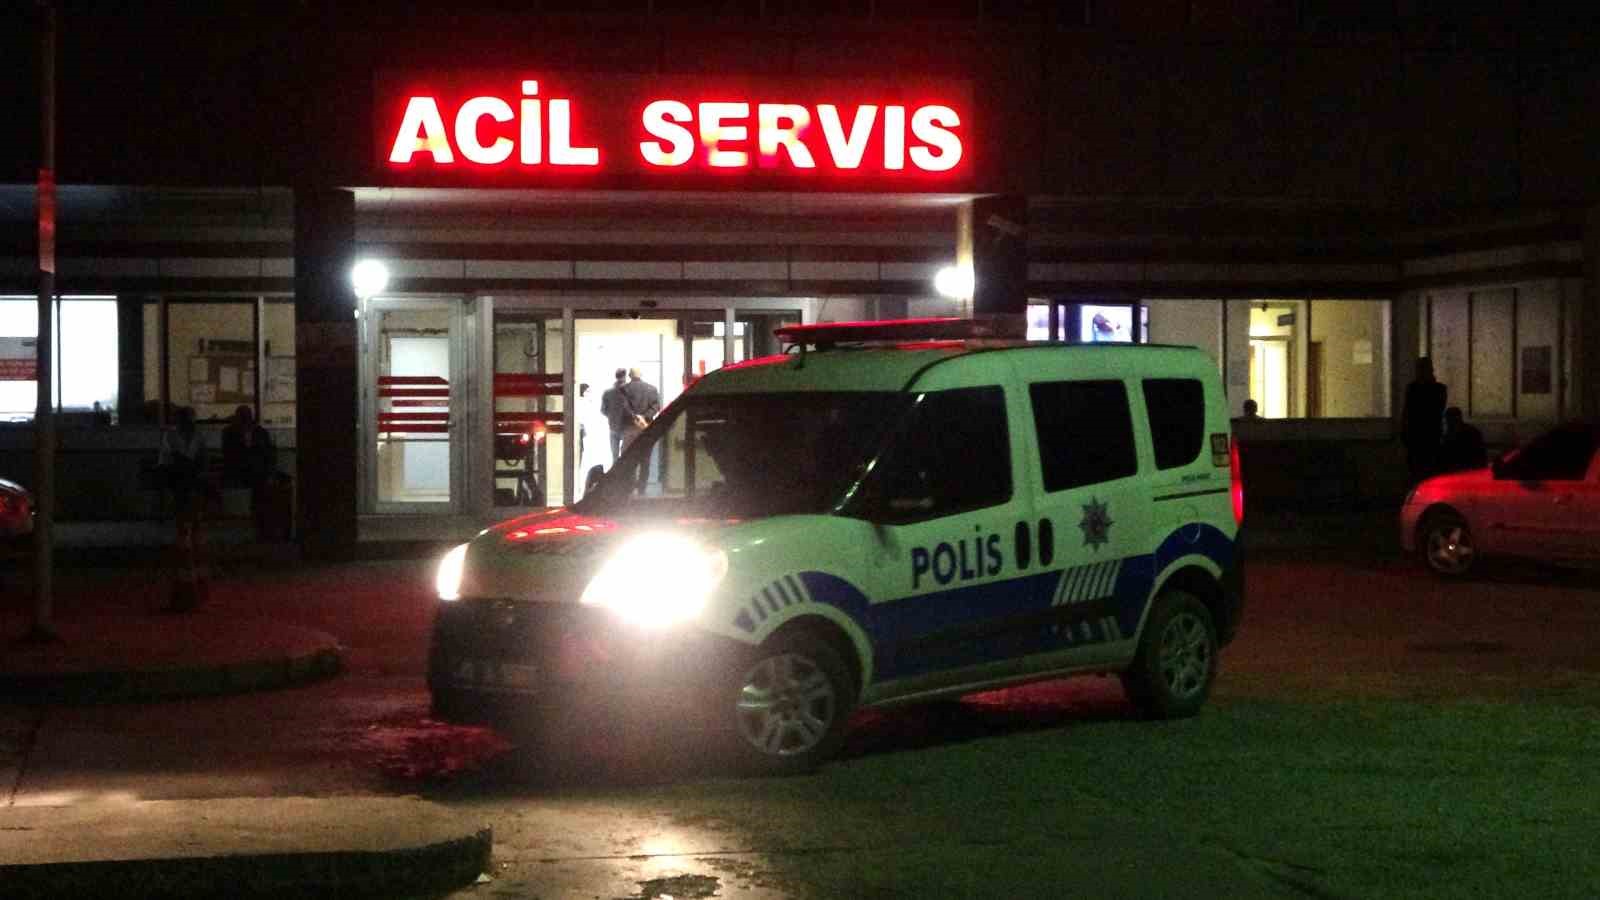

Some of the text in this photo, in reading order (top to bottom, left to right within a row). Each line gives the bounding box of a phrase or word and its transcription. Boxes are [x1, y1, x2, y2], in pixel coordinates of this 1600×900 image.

[388, 79, 963, 171] ACİL SERVIS
[911, 524, 1003, 589] POLİS
